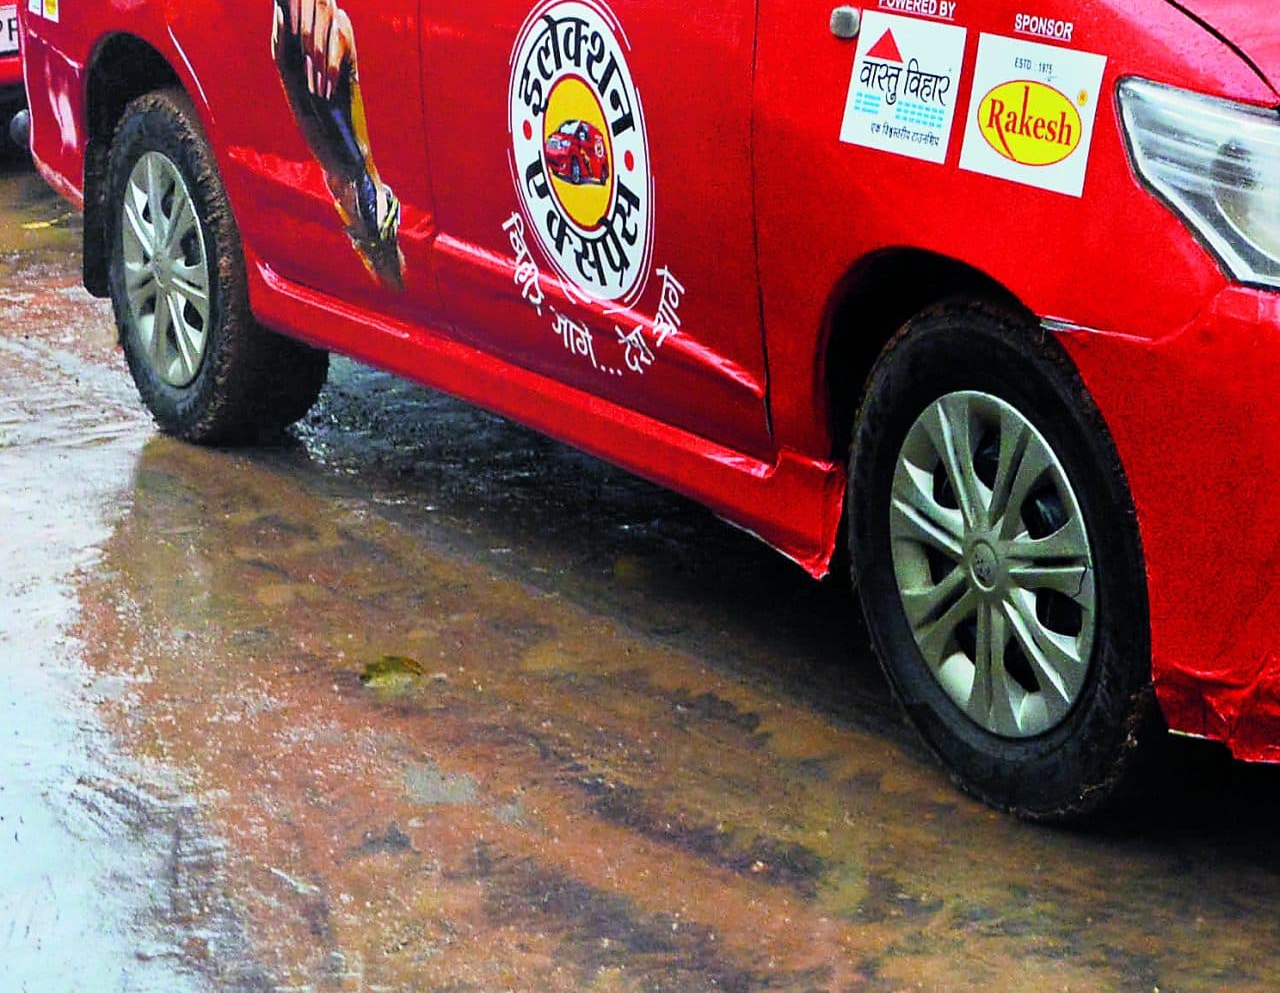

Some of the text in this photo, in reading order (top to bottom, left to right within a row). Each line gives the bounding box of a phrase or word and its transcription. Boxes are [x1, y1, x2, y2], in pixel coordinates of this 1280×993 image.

[938, 1, 958, 19] BY
[1014, 13, 1074, 40] SPONSOR
[519, 15, 637, 138] इलेक्शन
[859, 60, 904, 105] वास्तु
[903, 58, 951, 107] विहार
[1014, 57, 1032, 70] ESTD
[986, 85, 1073, 162] Rakesh
[526, 150, 640, 287] एक्सप्रेस
